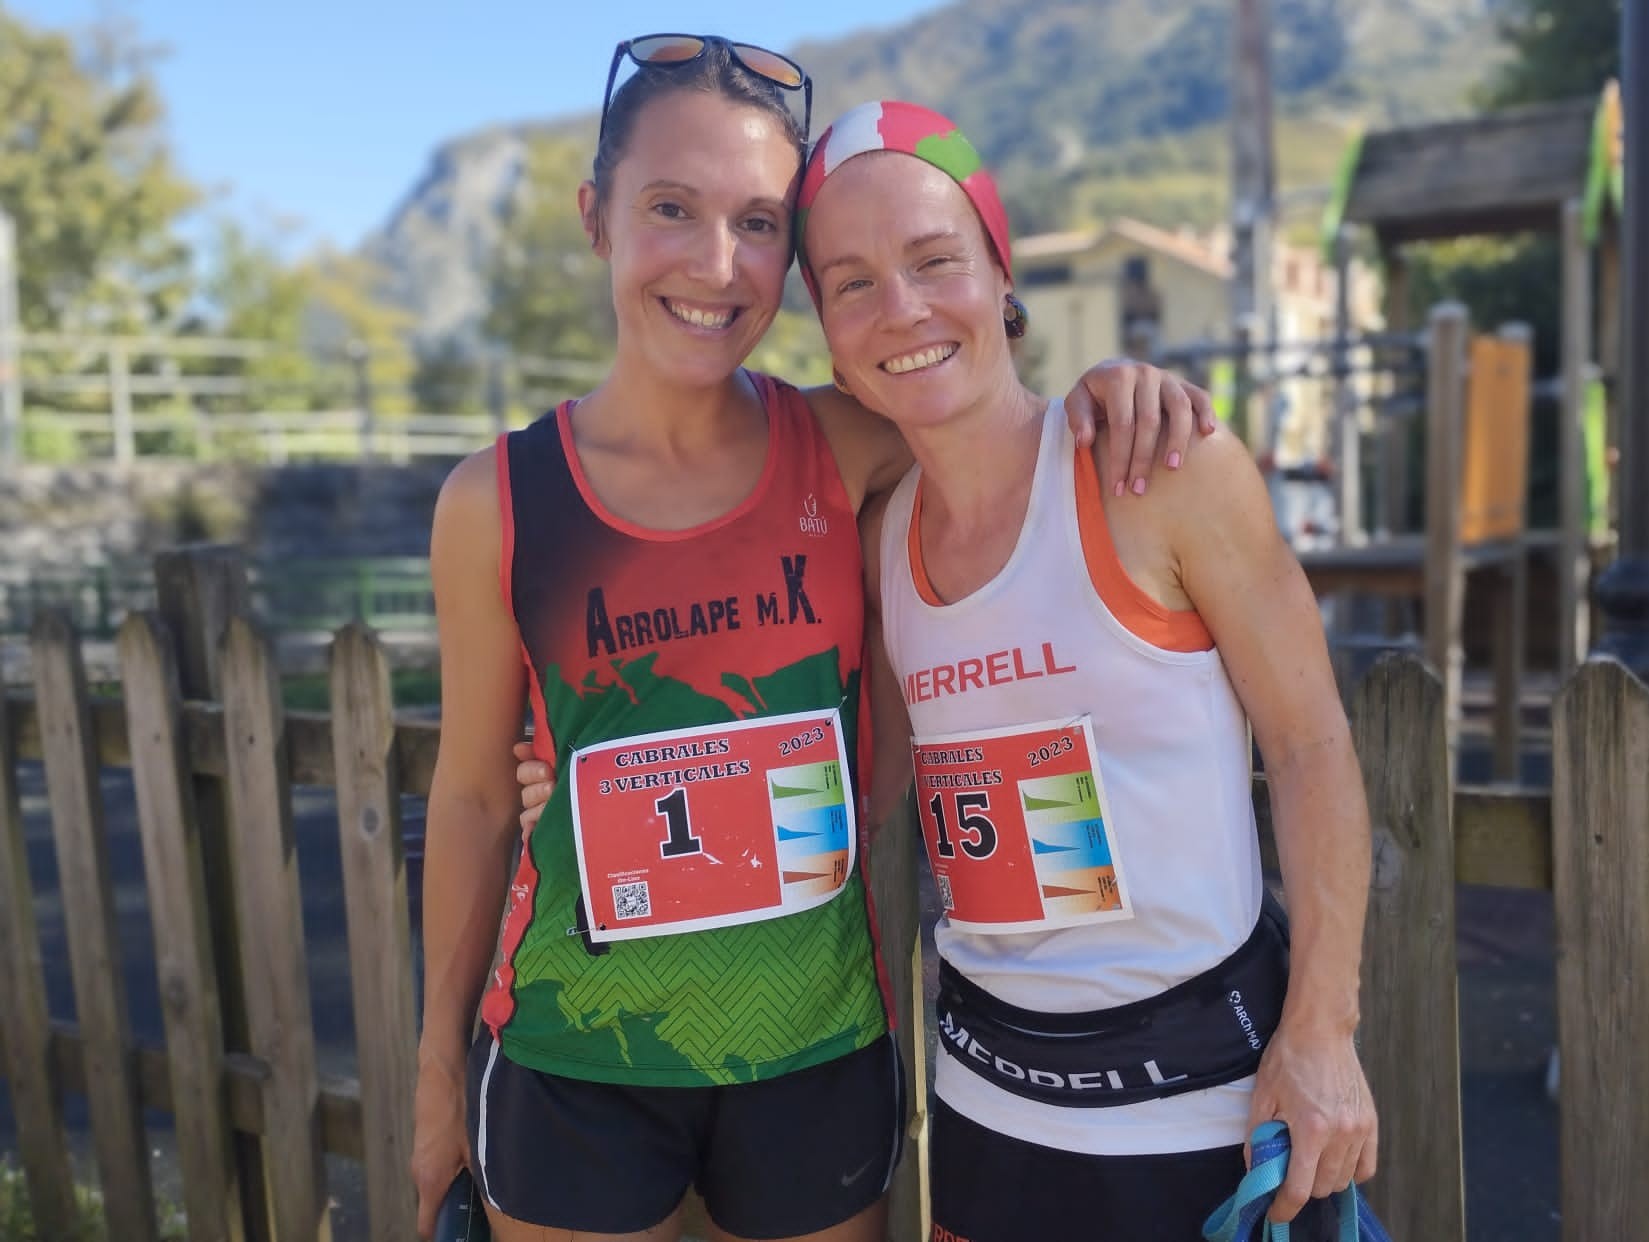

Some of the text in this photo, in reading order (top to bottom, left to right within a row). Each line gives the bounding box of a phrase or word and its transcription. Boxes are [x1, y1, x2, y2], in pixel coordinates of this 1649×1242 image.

[615, 727, 825, 768] CABRALES 2023
[921, 736, 1074, 766] CABRALES 2023
[600, 760, 750, 794] 3 VERTICALES
[655, 787, 702, 859] 1
[929, 791, 998, 861] 15
